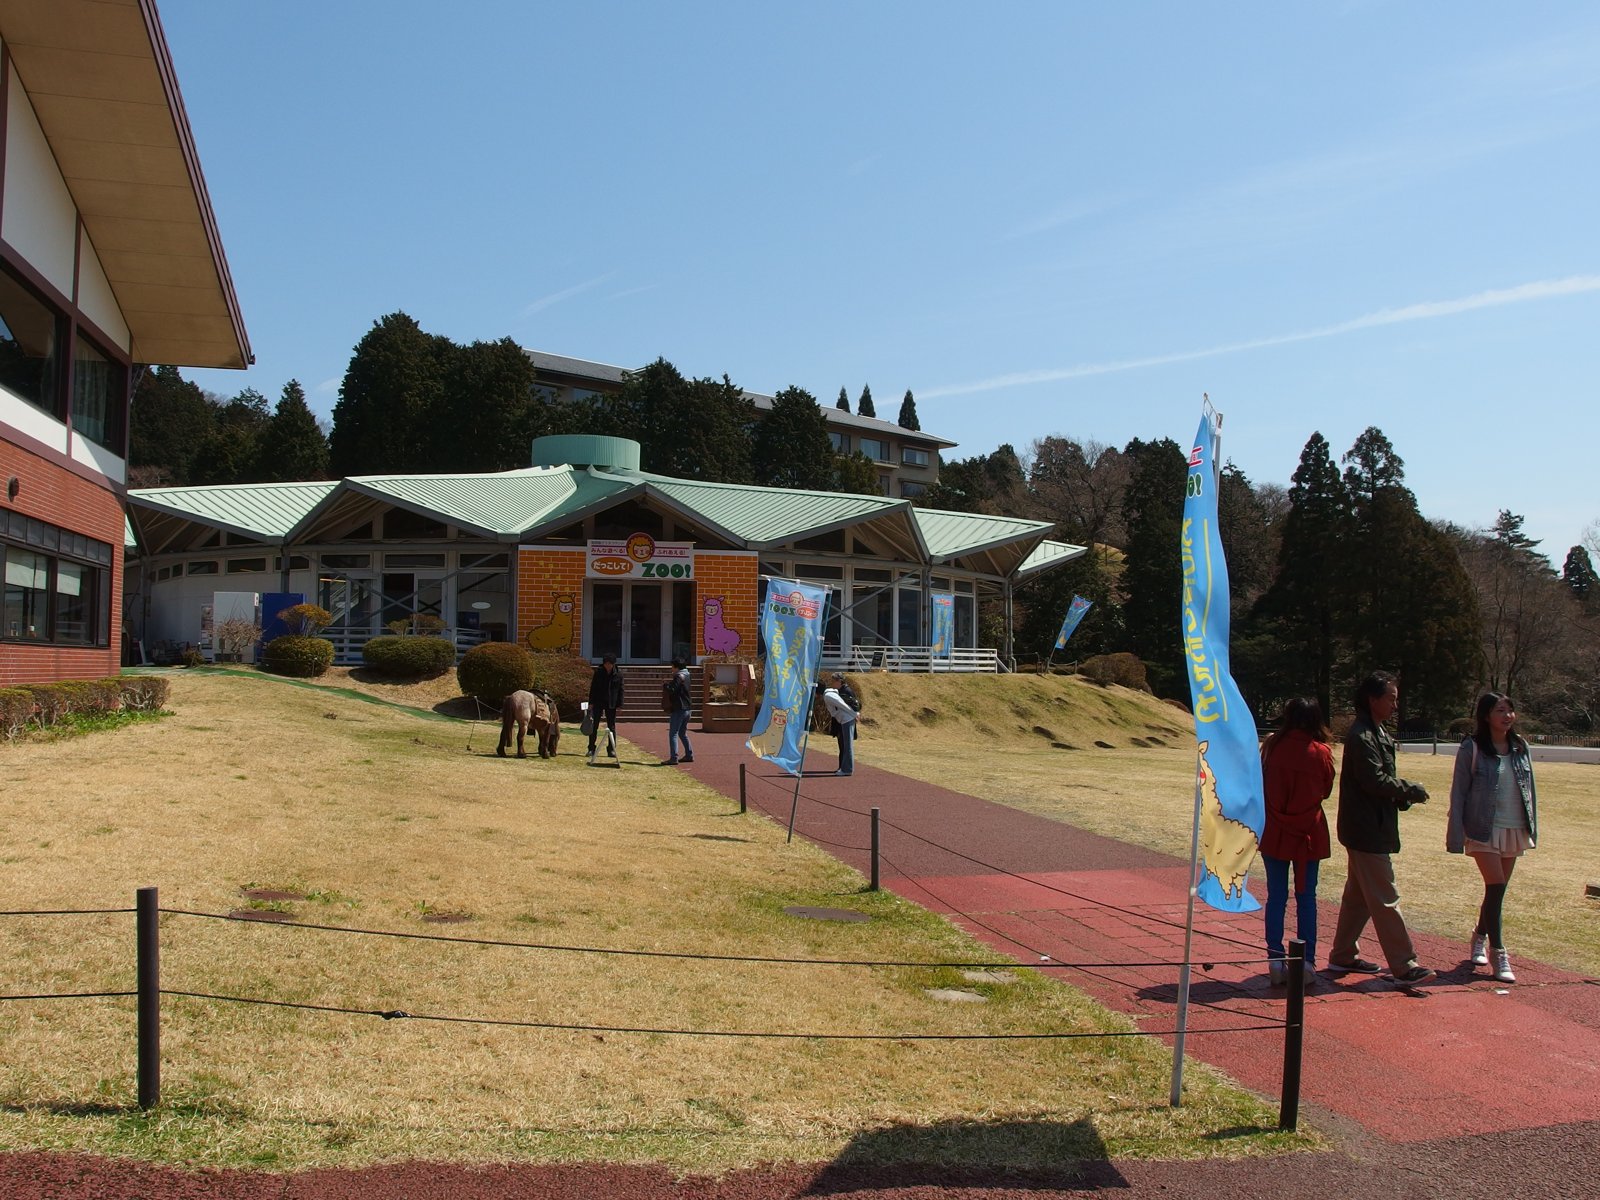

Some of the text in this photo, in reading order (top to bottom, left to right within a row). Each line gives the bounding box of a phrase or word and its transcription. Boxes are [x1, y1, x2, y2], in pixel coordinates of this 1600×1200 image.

[593, 560, 630, 571] だっこして!
[641, 562, 691, 578] ZOO!
